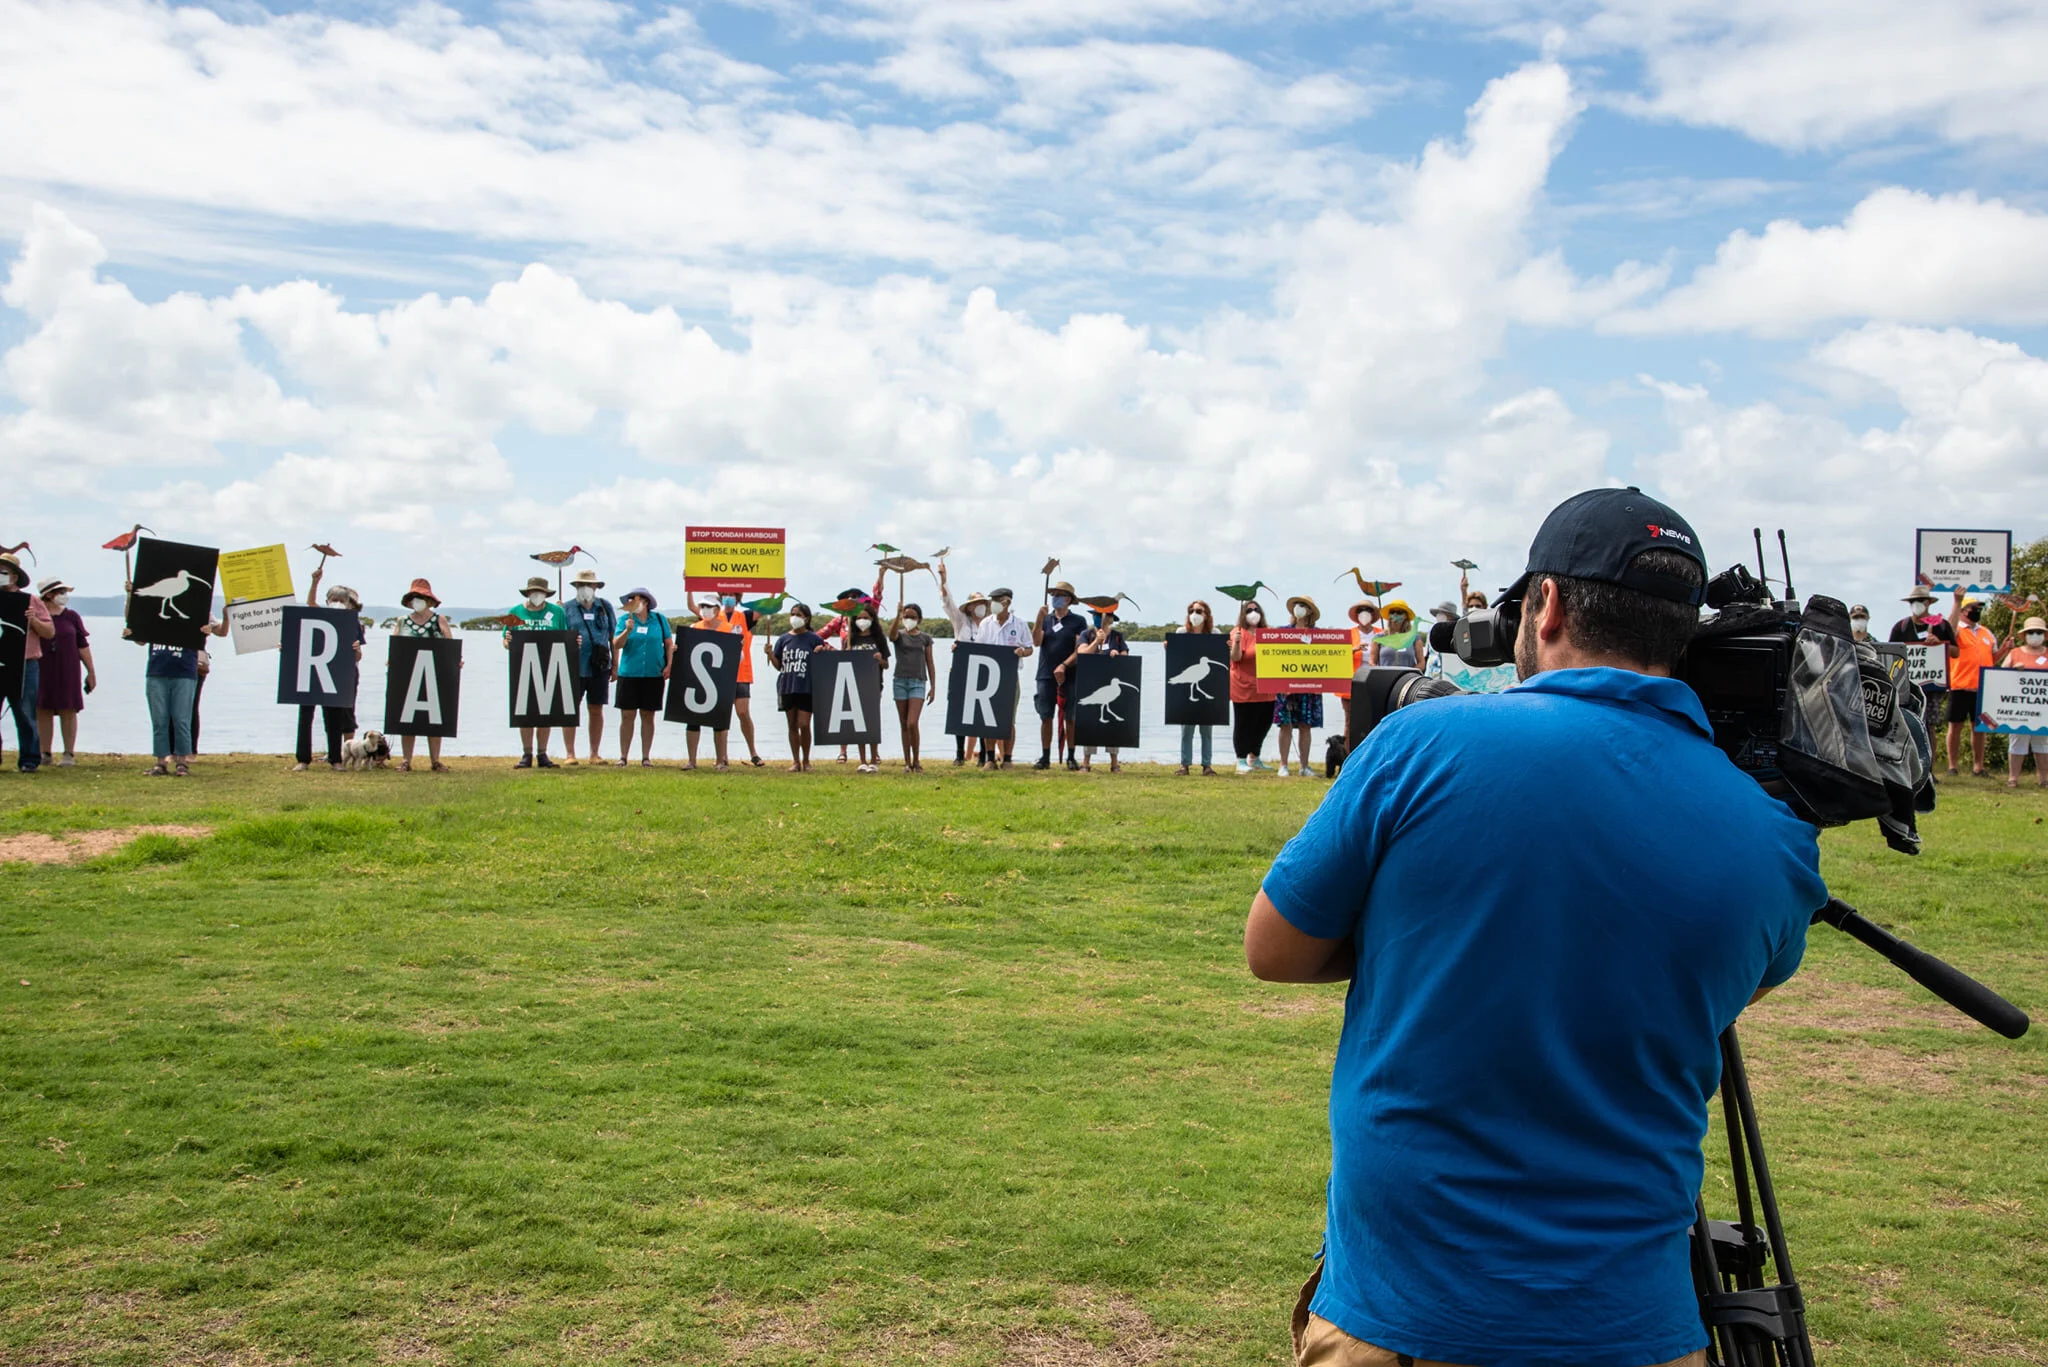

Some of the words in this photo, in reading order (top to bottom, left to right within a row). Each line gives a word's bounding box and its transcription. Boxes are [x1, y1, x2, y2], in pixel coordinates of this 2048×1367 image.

[711, 531, 743, 539] TOONDAH
[745, 532, 777, 540] HARBOUR
[1951, 538, 1976, 546] SAVE
[690, 547, 727, 556] HIGHRISE
[760, 549, 780, 557] BAY?
[1953, 547, 1974, 555] OUR
[1936, 556, 1991, 564] WETLANDS
[711, 563, 727, 572] NO
[731, 564, 759, 573] WAY!
[233, 611, 252, 621] Fight
[253, 609, 264, 617] for
[240, 621, 273, 631] Toondah
[297, 619, 339, 694] R
[795, 648, 809, 660] for
[1907, 647, 1928, 657] AVE
[1282, 664, 1298, 673] NO
[1301, 664, 1328, 673] WAY!
[515, 642, 576, 716] M
[684, 642, 724, 714] S
[1908, 670, 1944, 680] LANDS
[2019, 677, 2048, 687] SAVE
[399, 650, 443, 725] A
[962, 654, 1001, 727] R
[2021, 687, 2047, 696] OUR
[828, 661, 867, 734] A
[1863, 687, 1888, 707] orta
[1997, 708, 2013, 716] TAKE
